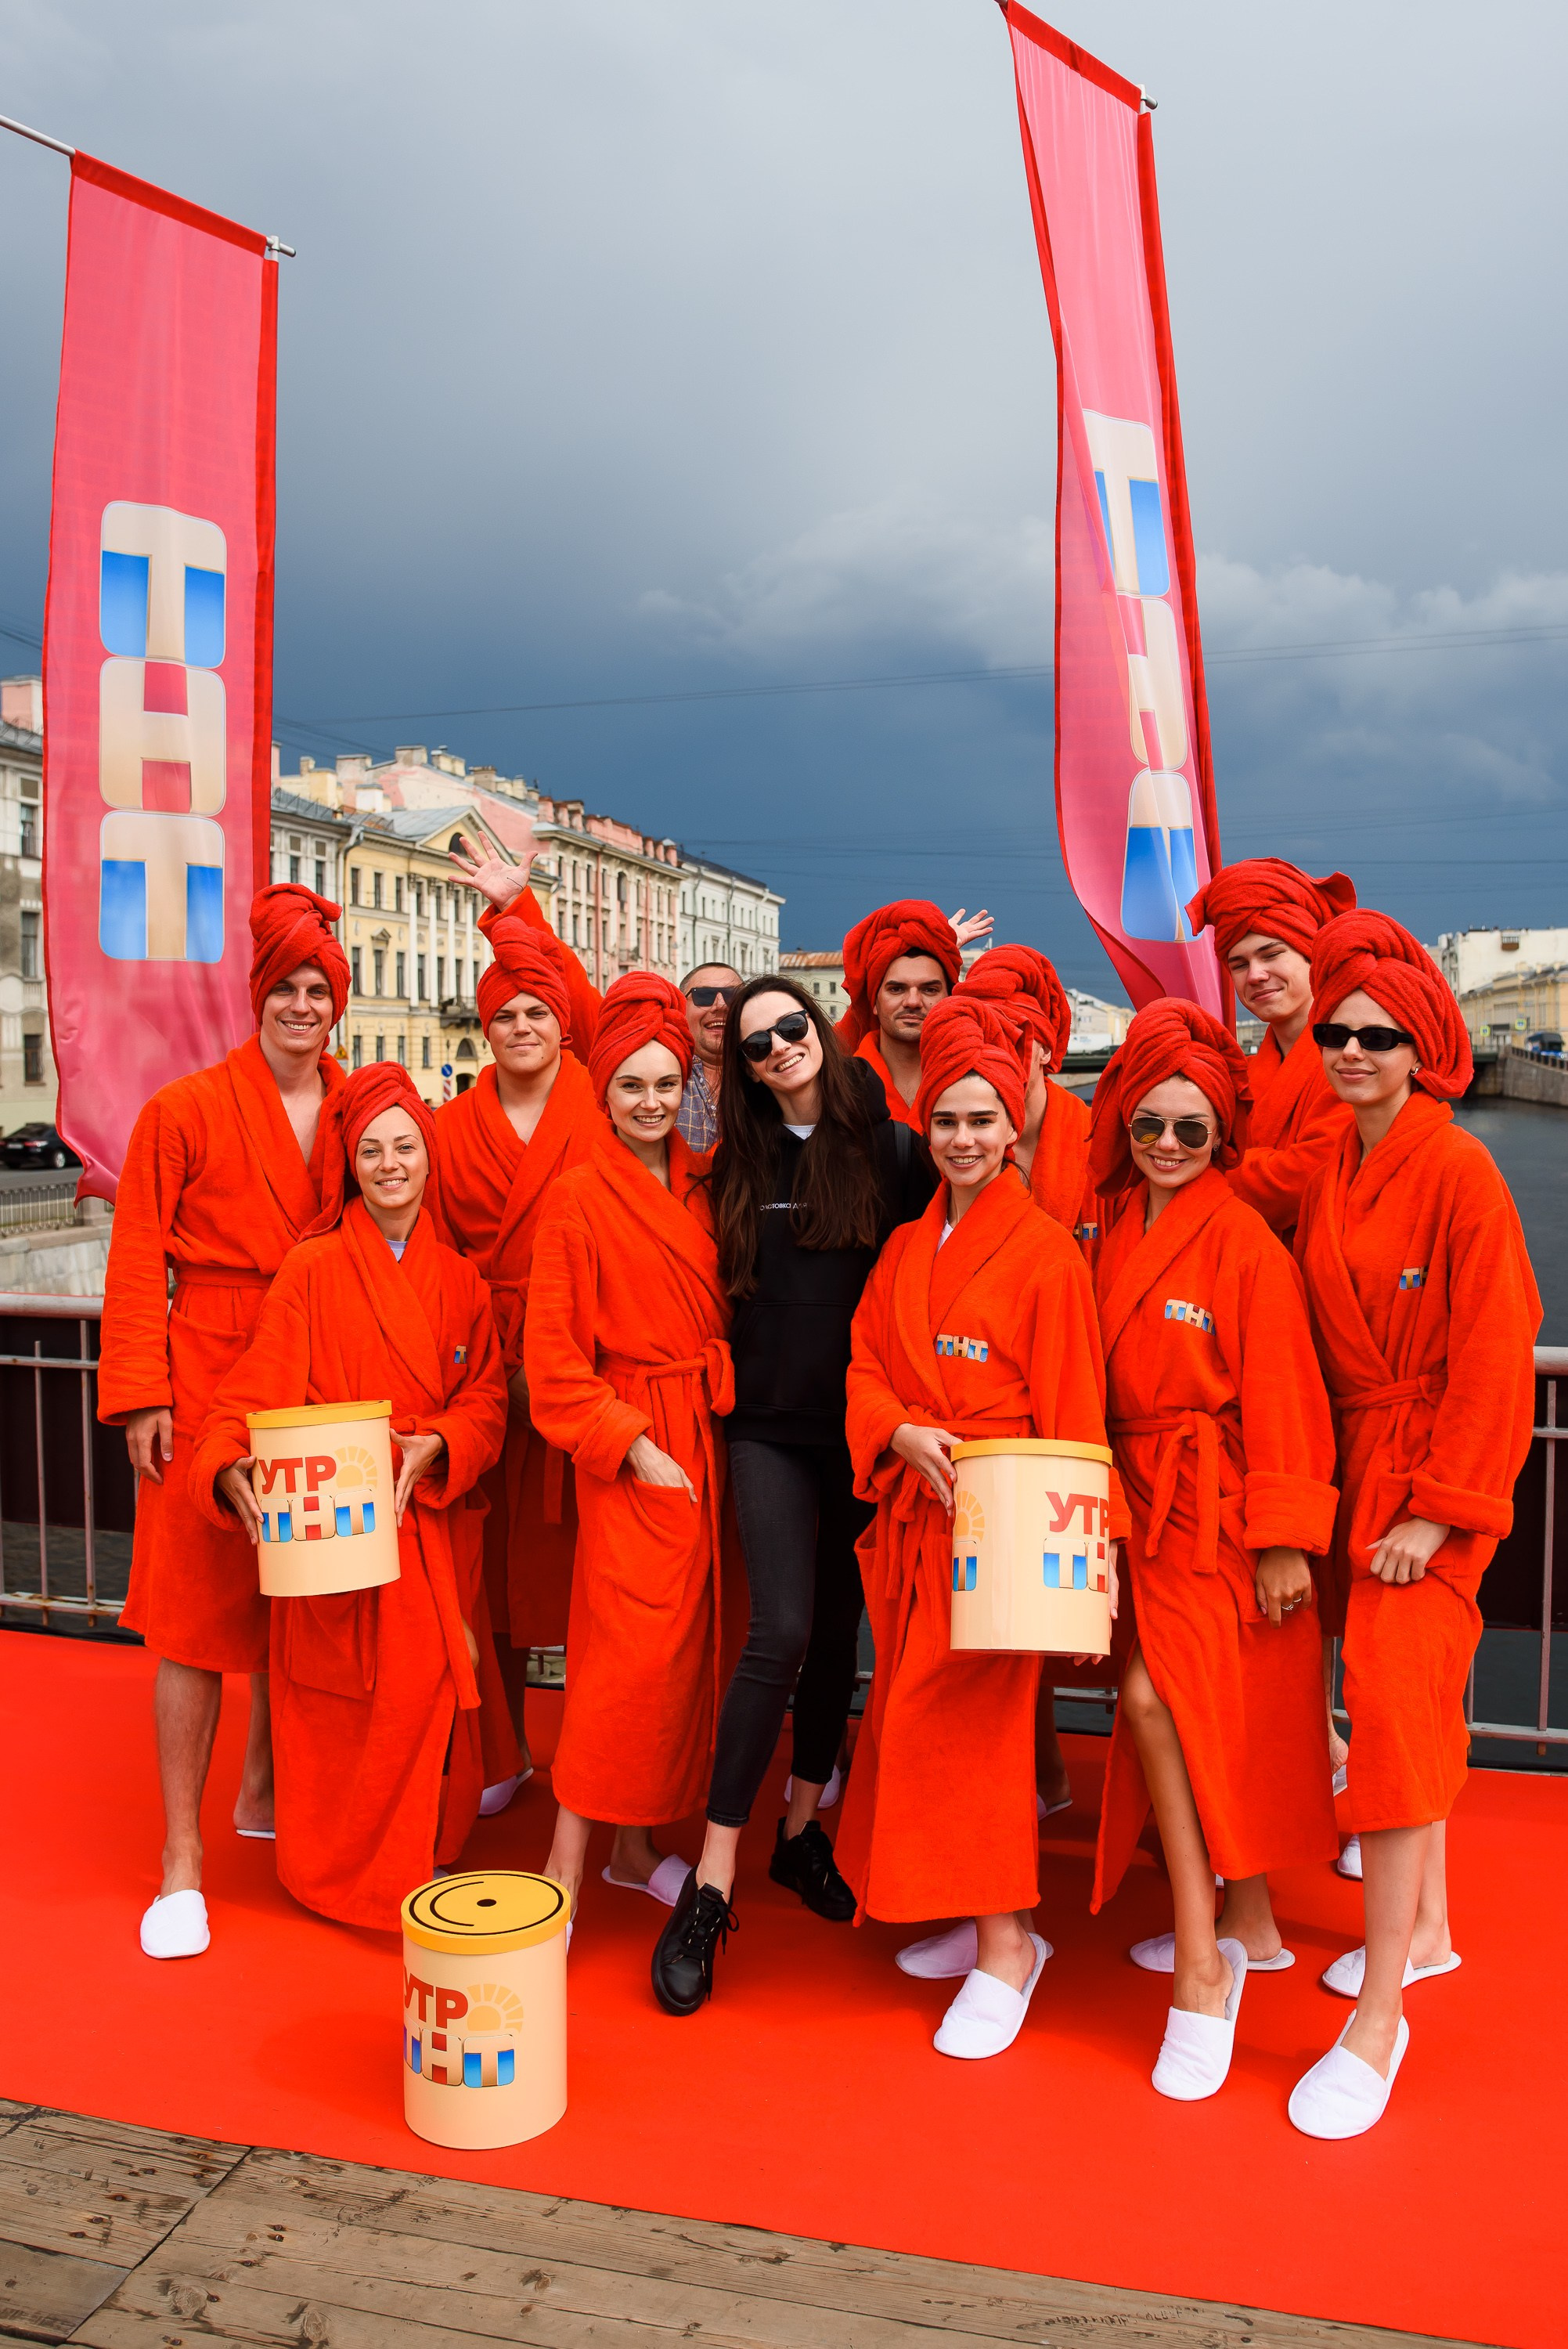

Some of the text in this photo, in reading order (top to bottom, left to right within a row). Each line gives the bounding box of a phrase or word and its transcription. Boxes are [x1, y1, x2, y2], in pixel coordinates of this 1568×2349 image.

[99, 500, 227, 964] ТНТ
[1164, 1298, 1216, 1336] ТНТ
[936, 1333, 989, 1362] ТНТ
[261, 1488, 376, 1543] ТНТ
